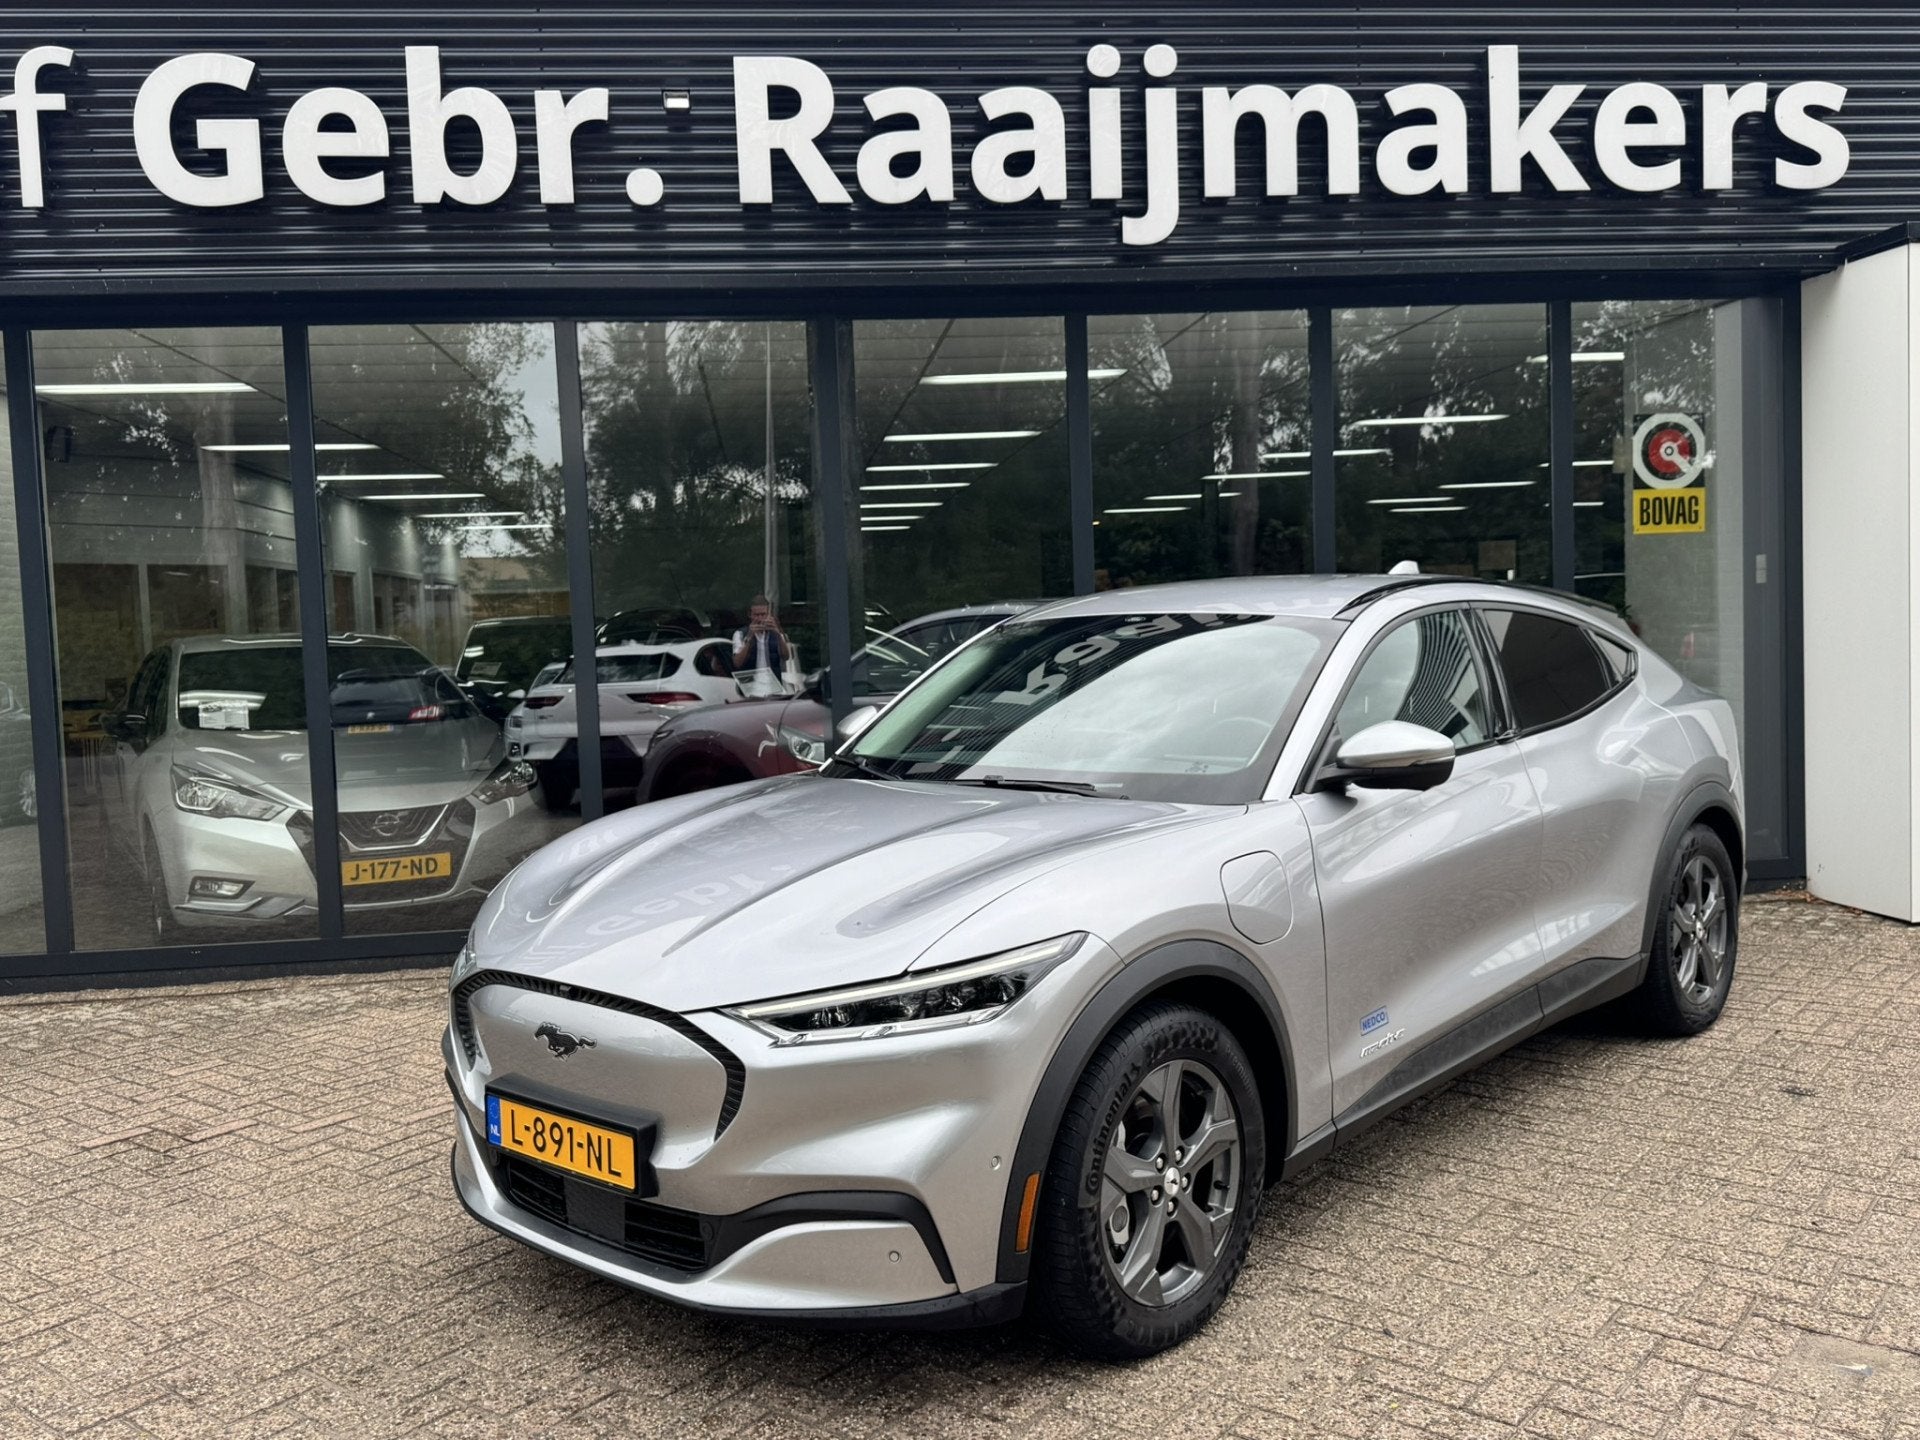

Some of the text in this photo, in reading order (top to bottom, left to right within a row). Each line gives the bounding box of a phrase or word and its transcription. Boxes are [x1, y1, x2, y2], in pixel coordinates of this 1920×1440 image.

[133, 45, 664, 207] Gebr.
[732, 44, 1850, 246] Raaijmakers
[1639, 496, 1699, 526] BOVAG
[350, 857, 438, 881] J-177-ND
[489, 1123, 501, 1138] NL
[511, 1109, 622, 1178] L-891-NL
[1085, 1071, 1134, 1196] Continental
